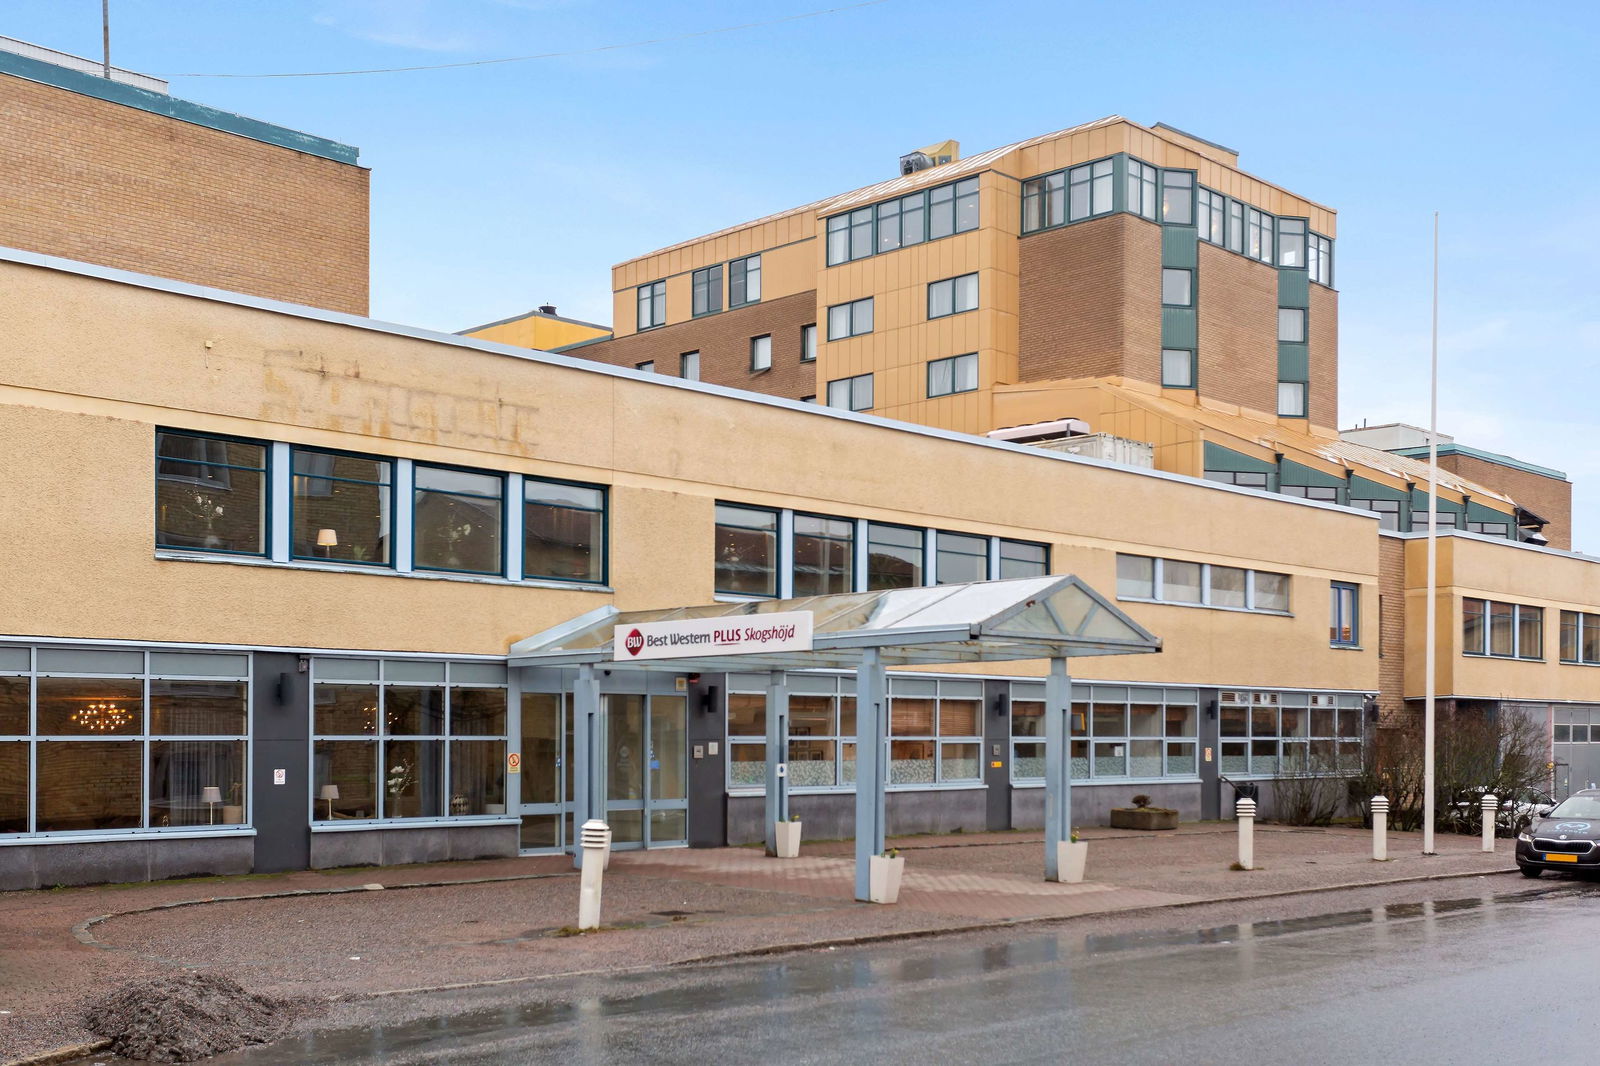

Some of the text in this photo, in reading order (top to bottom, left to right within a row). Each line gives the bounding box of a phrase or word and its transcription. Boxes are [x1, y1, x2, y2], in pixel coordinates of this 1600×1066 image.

[627, 636, 642, 648] BW
[646, 624, 796, 647] Best Western PLUS Skogshöjd
